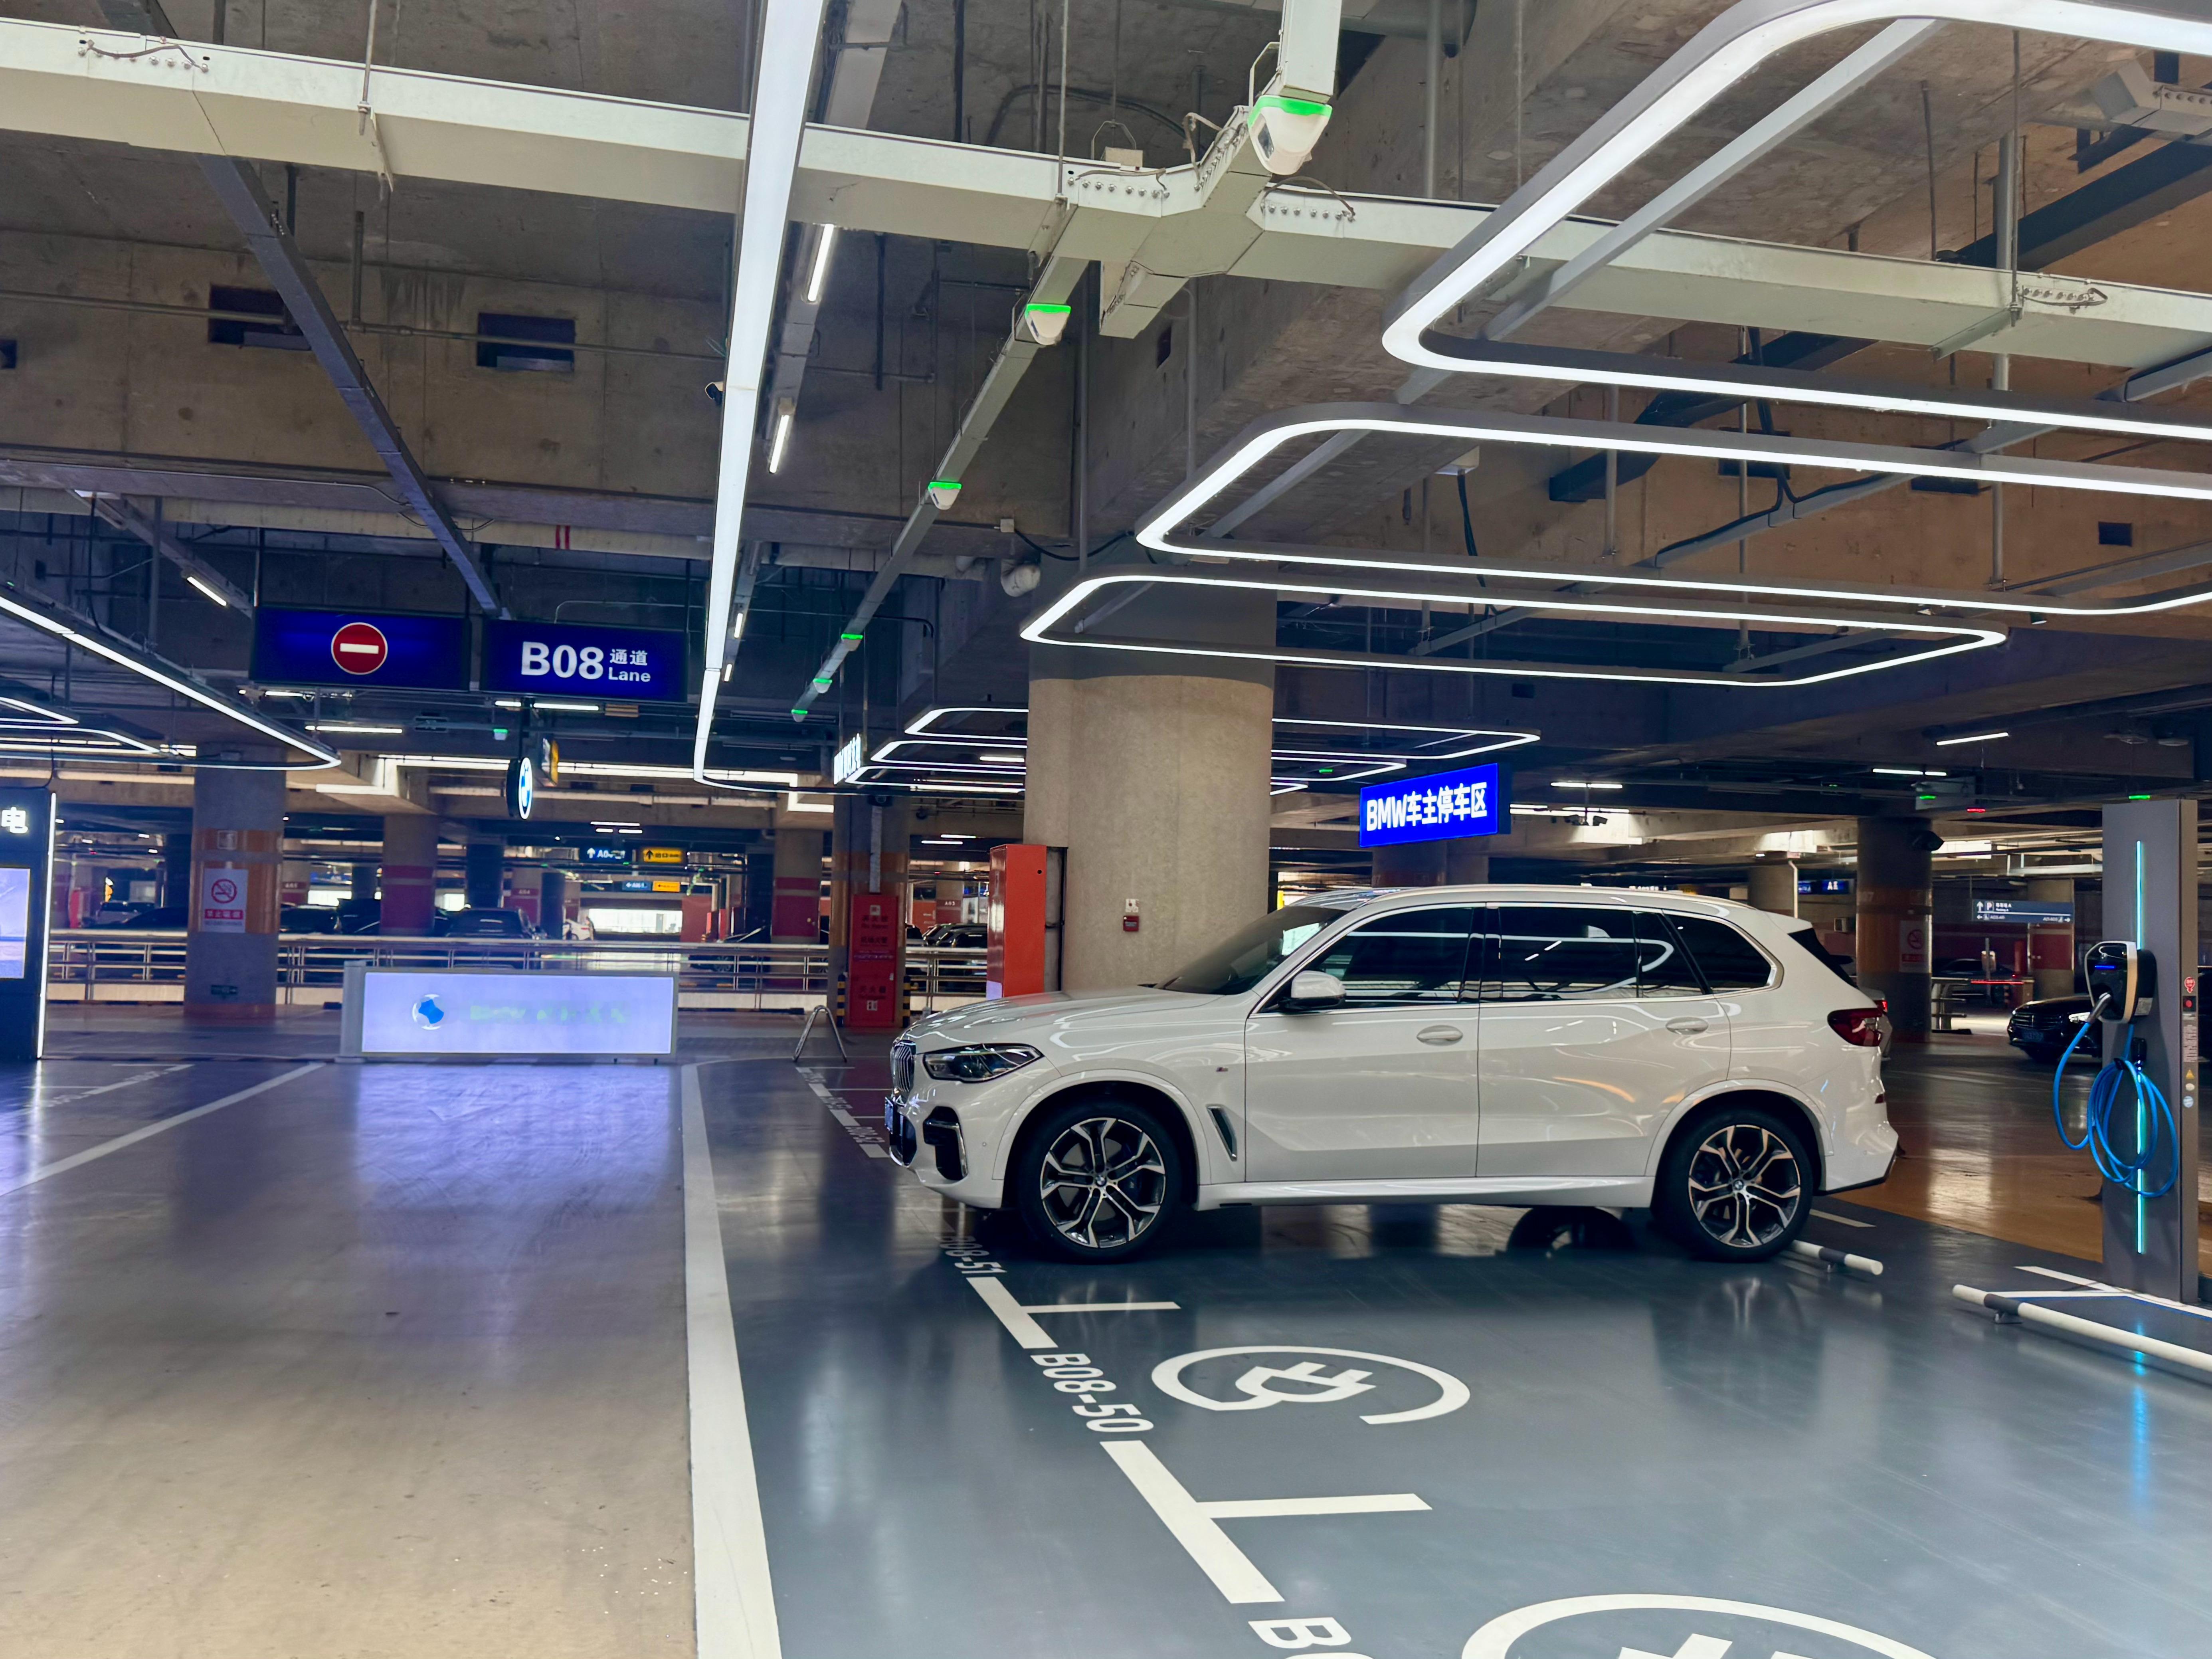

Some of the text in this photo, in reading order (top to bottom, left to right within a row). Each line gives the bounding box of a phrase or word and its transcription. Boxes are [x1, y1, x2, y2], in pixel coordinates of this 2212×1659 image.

[521, 641, 648, 679] B08 通道
[608, 667, 651, 682] Lane
[1366, 782, 1488, 831] BMW车主停车区
[934, 1235, 1007, 1274] B08-51
[1030, 1353, 1154, 1432] B08-50
[1247, 1617, 1374, 1659] B
